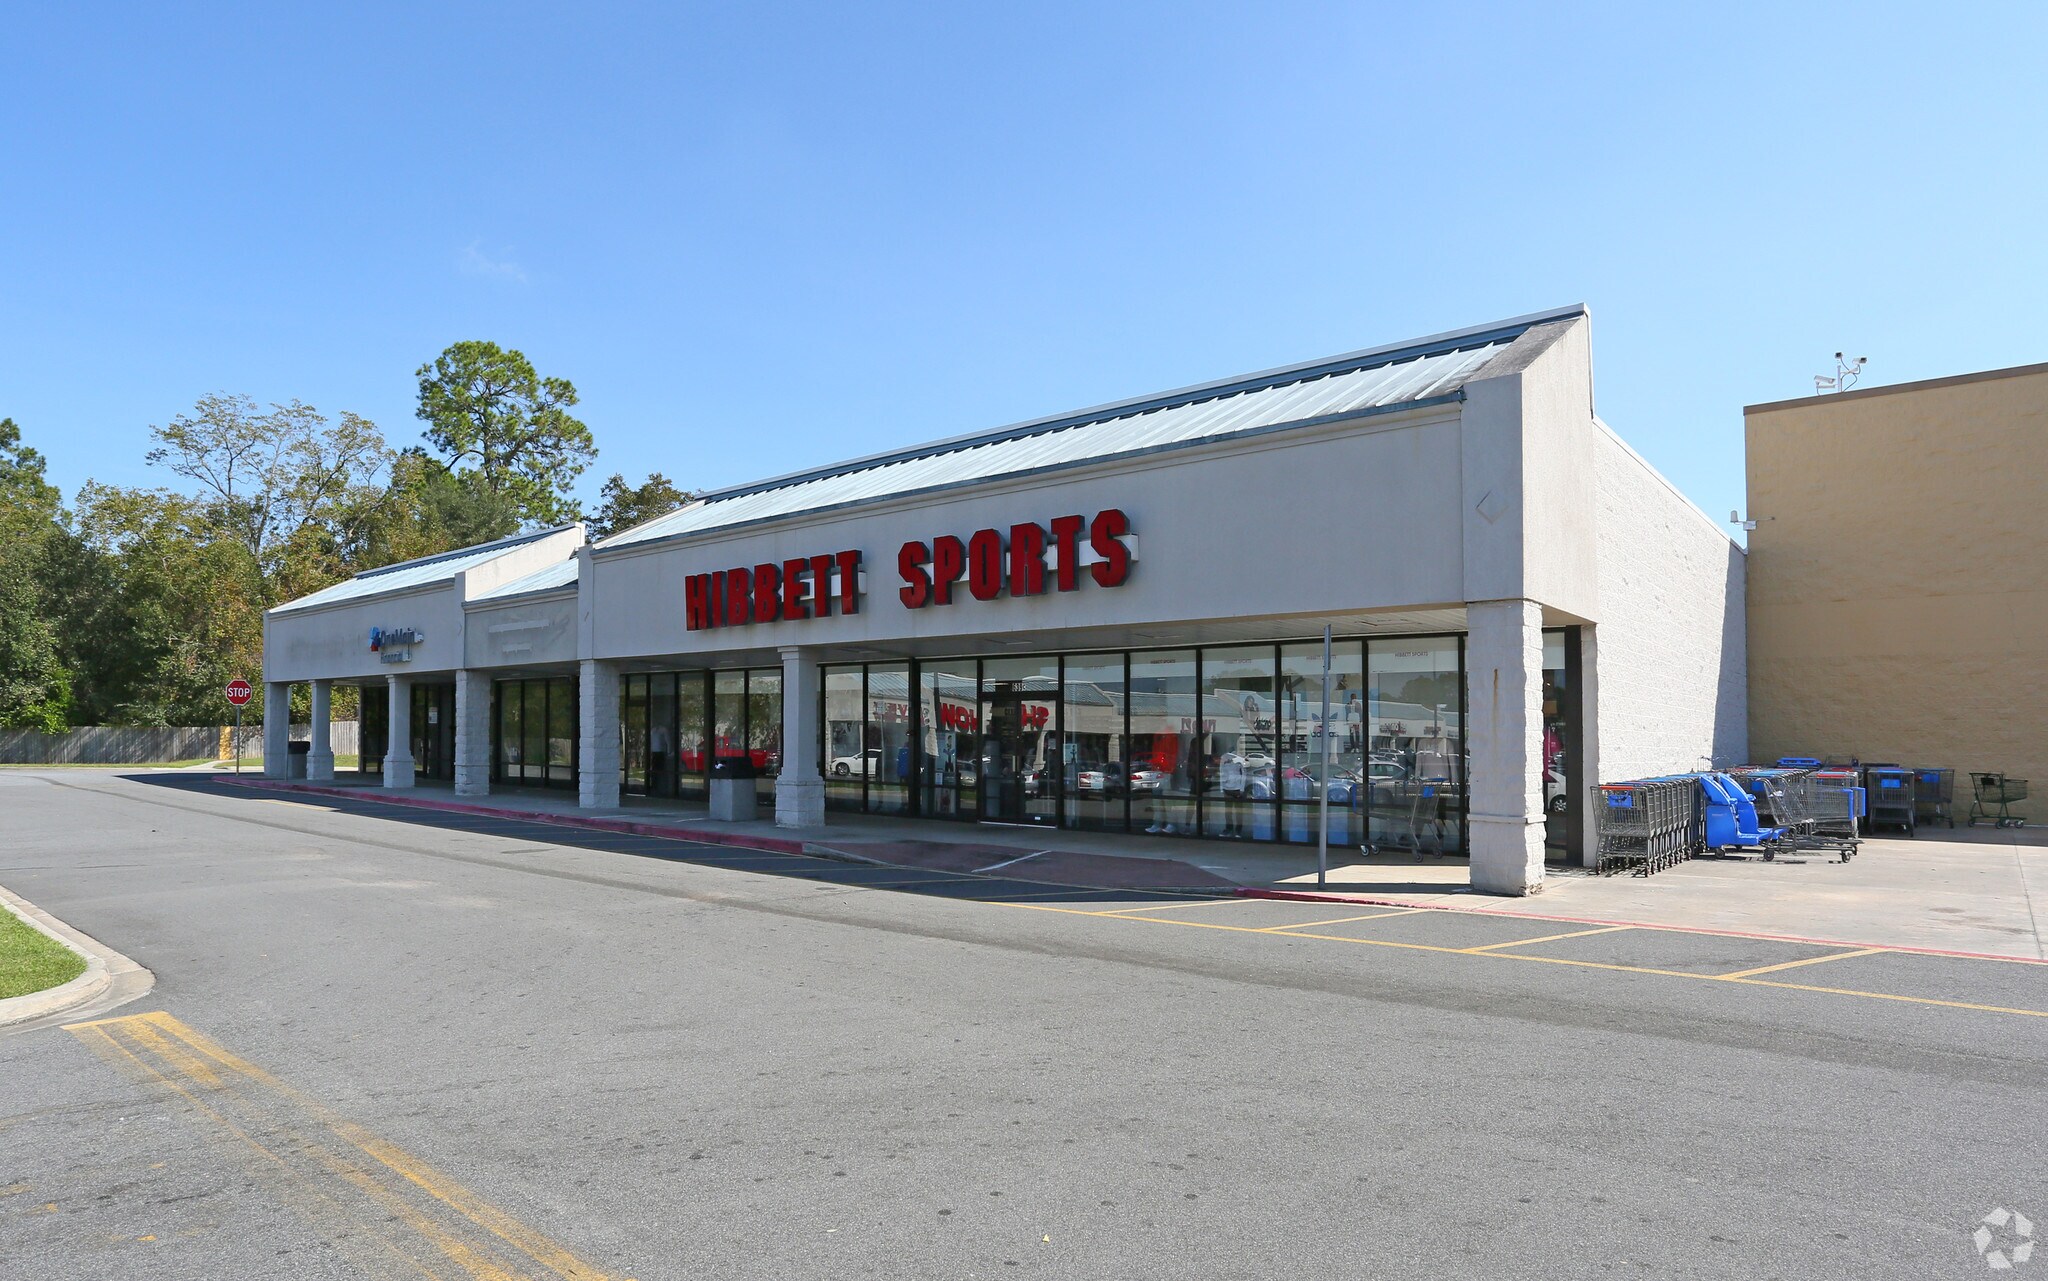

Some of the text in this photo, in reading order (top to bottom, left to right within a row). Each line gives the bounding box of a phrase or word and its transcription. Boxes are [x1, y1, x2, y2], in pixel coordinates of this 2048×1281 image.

[685, 509, 1130, 631] HIBBETT SPORTS
[228, 687, 250, 698] STOP
